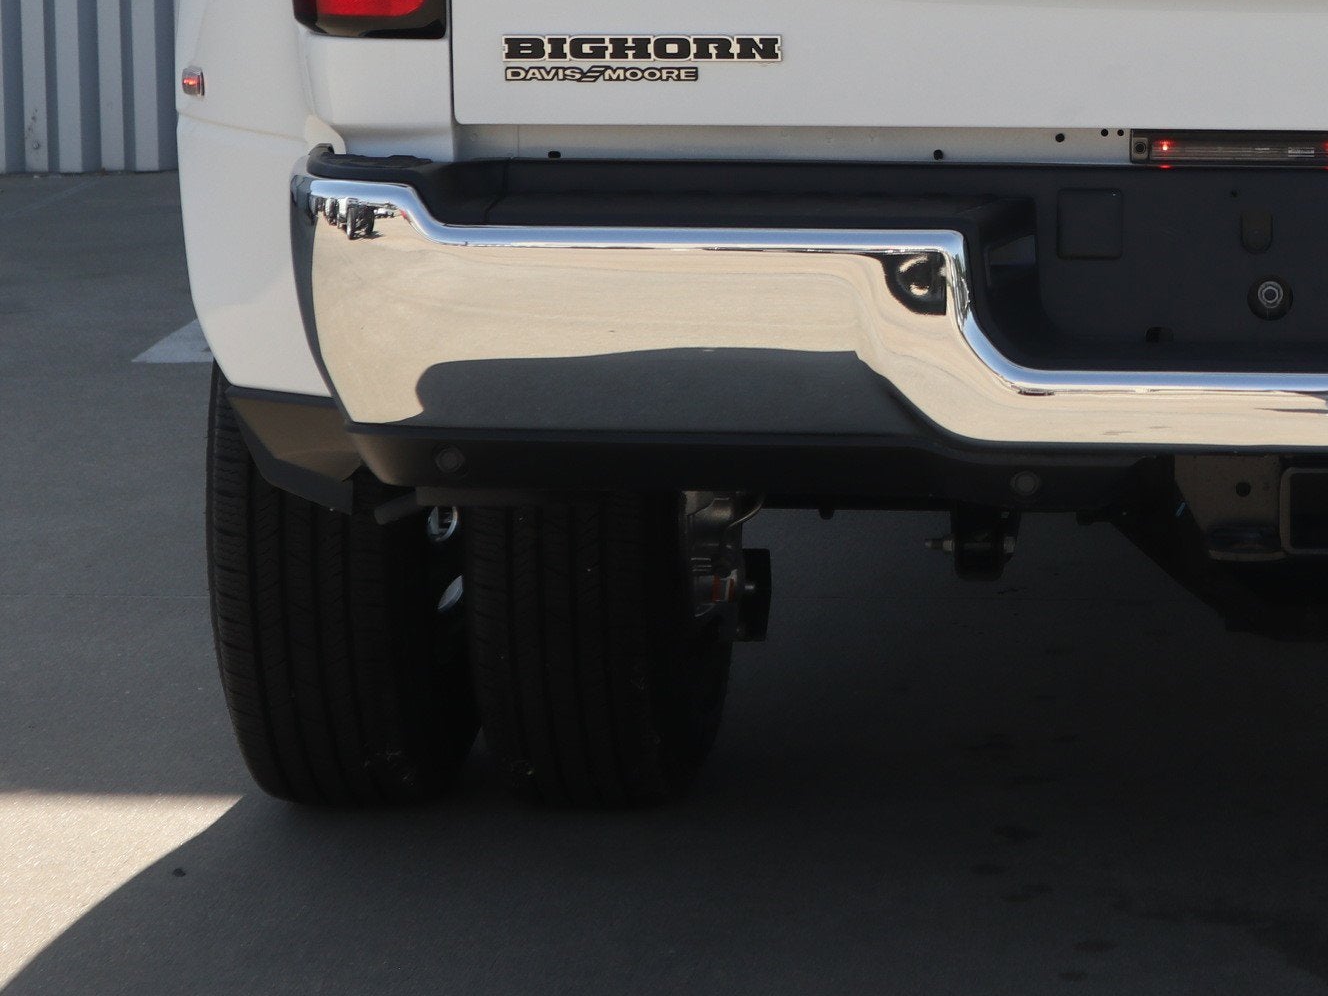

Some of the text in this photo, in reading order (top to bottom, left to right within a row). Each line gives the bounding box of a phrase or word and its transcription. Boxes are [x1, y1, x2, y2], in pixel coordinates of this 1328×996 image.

[503, 35, 782, 61] BIGHORN
[505, 67, 698, 81] DAVIS MOORE
